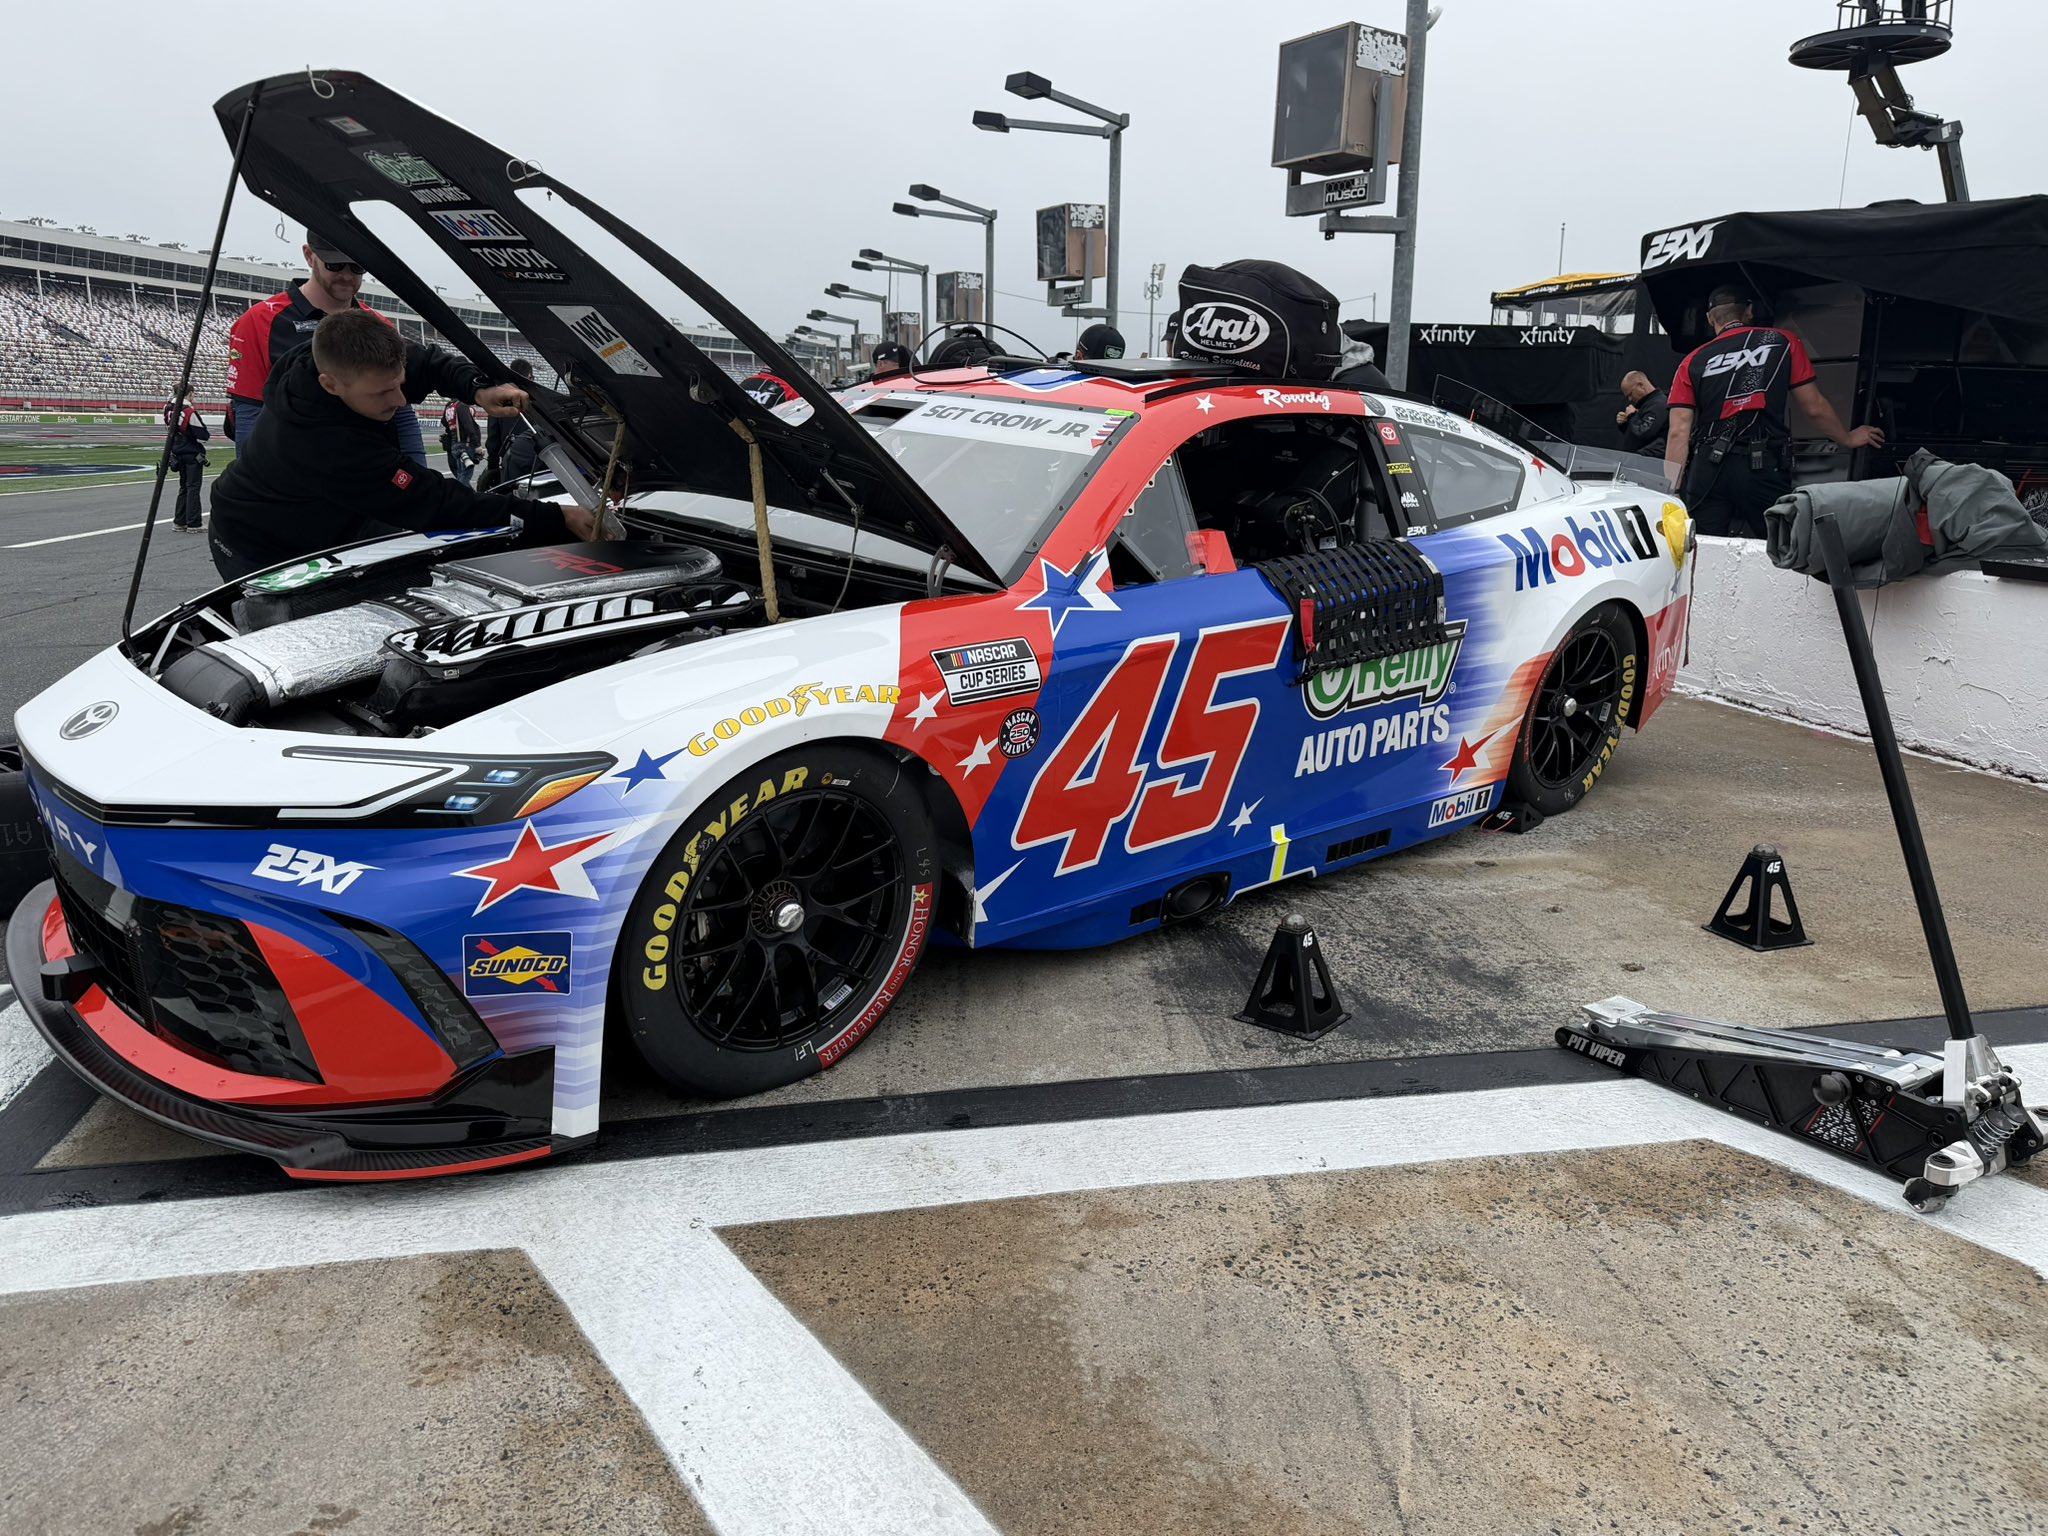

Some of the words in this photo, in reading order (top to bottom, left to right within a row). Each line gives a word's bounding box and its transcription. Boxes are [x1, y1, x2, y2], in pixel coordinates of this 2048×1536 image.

[434, 214, 501, 237] Mobil
[1643, 220, 1726, 270] 23XI
[469, 247, 558, 269] TOYOTA
[502, 271, 566, 280] RACING
[571, 312, 620, 348] WIX
[1184, 307, 1257, 342] Arai
[1419, 324, 1476, 345] xfinity
[1519, 326, 1575, 345] xfinity
[1200, 339, 1234, 348] HELMET
[1702, 343, 1783, 378] 23XI
[1255, 388, 1332, 411] Rowdy
[24, 414, 40, 423] ZONE
[921, 405, 975, 420] SGT
[970, 411, 1053, 431] CROW
[1047, 421, 1090, 438] JR
[1406, 526, 1428, 537] 23XI
[1500, 510, 1632, 592] Mobil
[1615, 506, 1659, 560] 1
[967, 644, 1017, 665] NASCAR
[960, 671, 983, 689] CUP
[985, 665, 1026, 685] SERIES
[1005, 711, 1036, 729] NASCAR
[1011, 728, 1030, 739] 250
[1295, 722, 1367, 777] AUTO
[1369, 704, 1450, 758] PARTS
[1003, 735, 1035, 755] SALUTES
[1011, 614, 1293, 877] 45
[1431, 793, 1474, 825] Mobil
[1496, 811, 1512, 820] 45
[251, 843, 384, 894] 23XI
[1767, 861, 1781, 874] 45
[899, 907, 929, 967] HONOR
[1302, 931, 1313, 948] 45
[474, 955, 566, 976] SUNOCO
[890, 969, 903, 990] AND
[822, 989, 893, 1061] REMEMBER
[1567, 1034, 1590, 1051] PIT
[1589, 1042, 1626, 1067] VIPER
